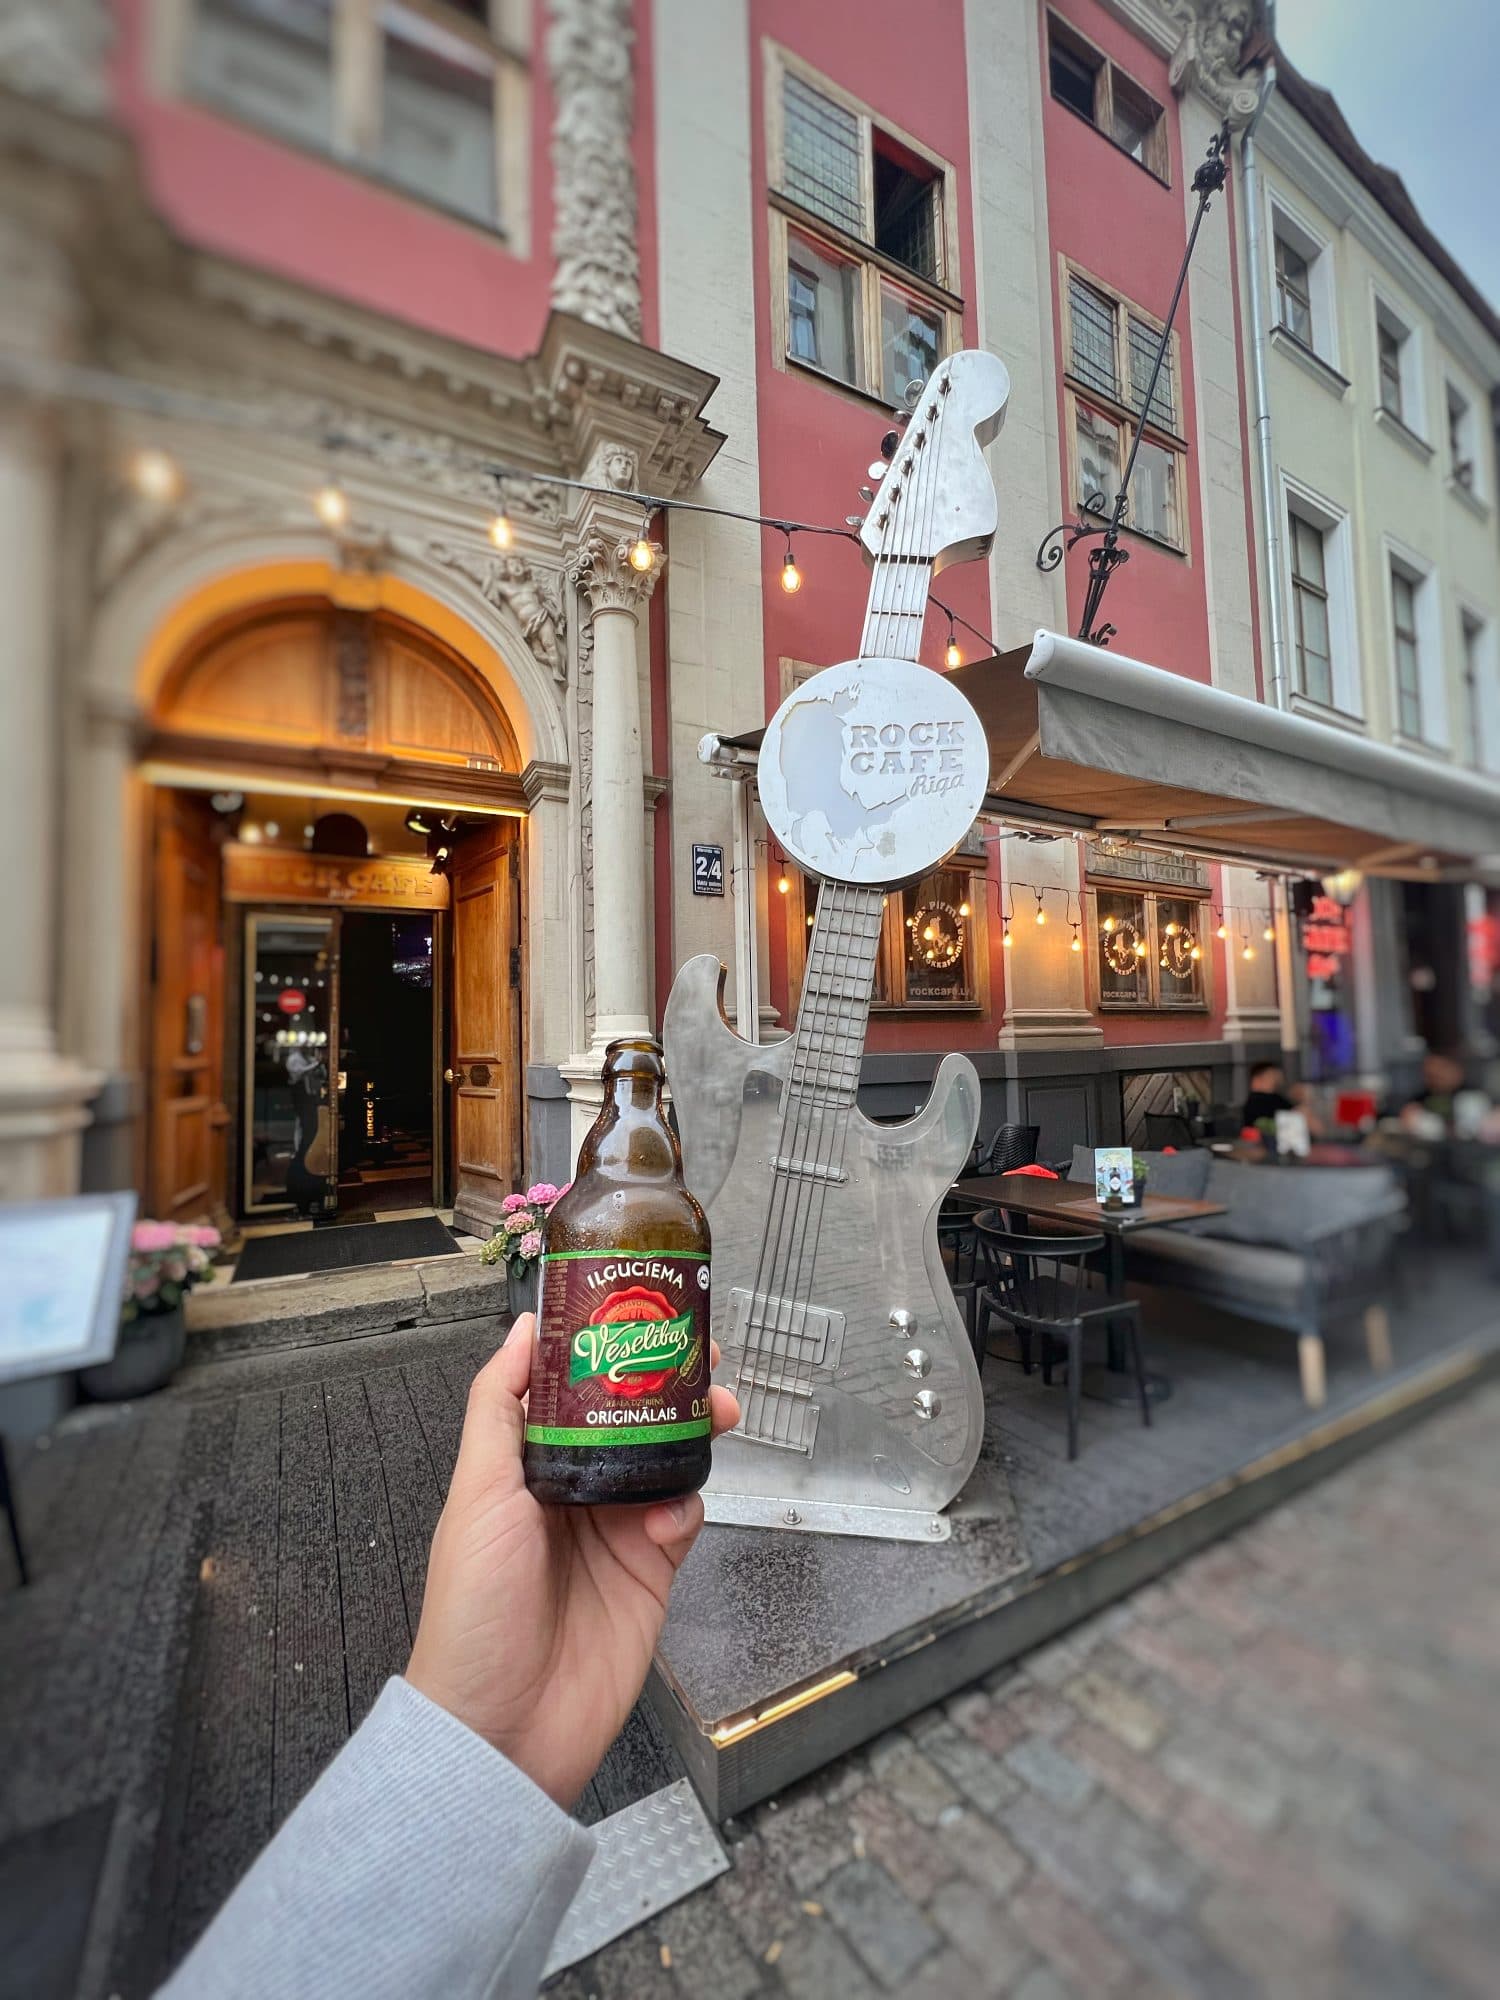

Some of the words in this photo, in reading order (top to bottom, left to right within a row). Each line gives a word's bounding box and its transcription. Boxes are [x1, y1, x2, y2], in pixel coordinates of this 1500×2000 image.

[850, 721, 965, 748] ROCK
[850, 748, 963, 775] CAFE
[696, 856, 722, 880] 2/4
[574, 1319, 688, 1383] Veselības
[586, 1406, 678, 1426] ORIĢINĀLAIS
